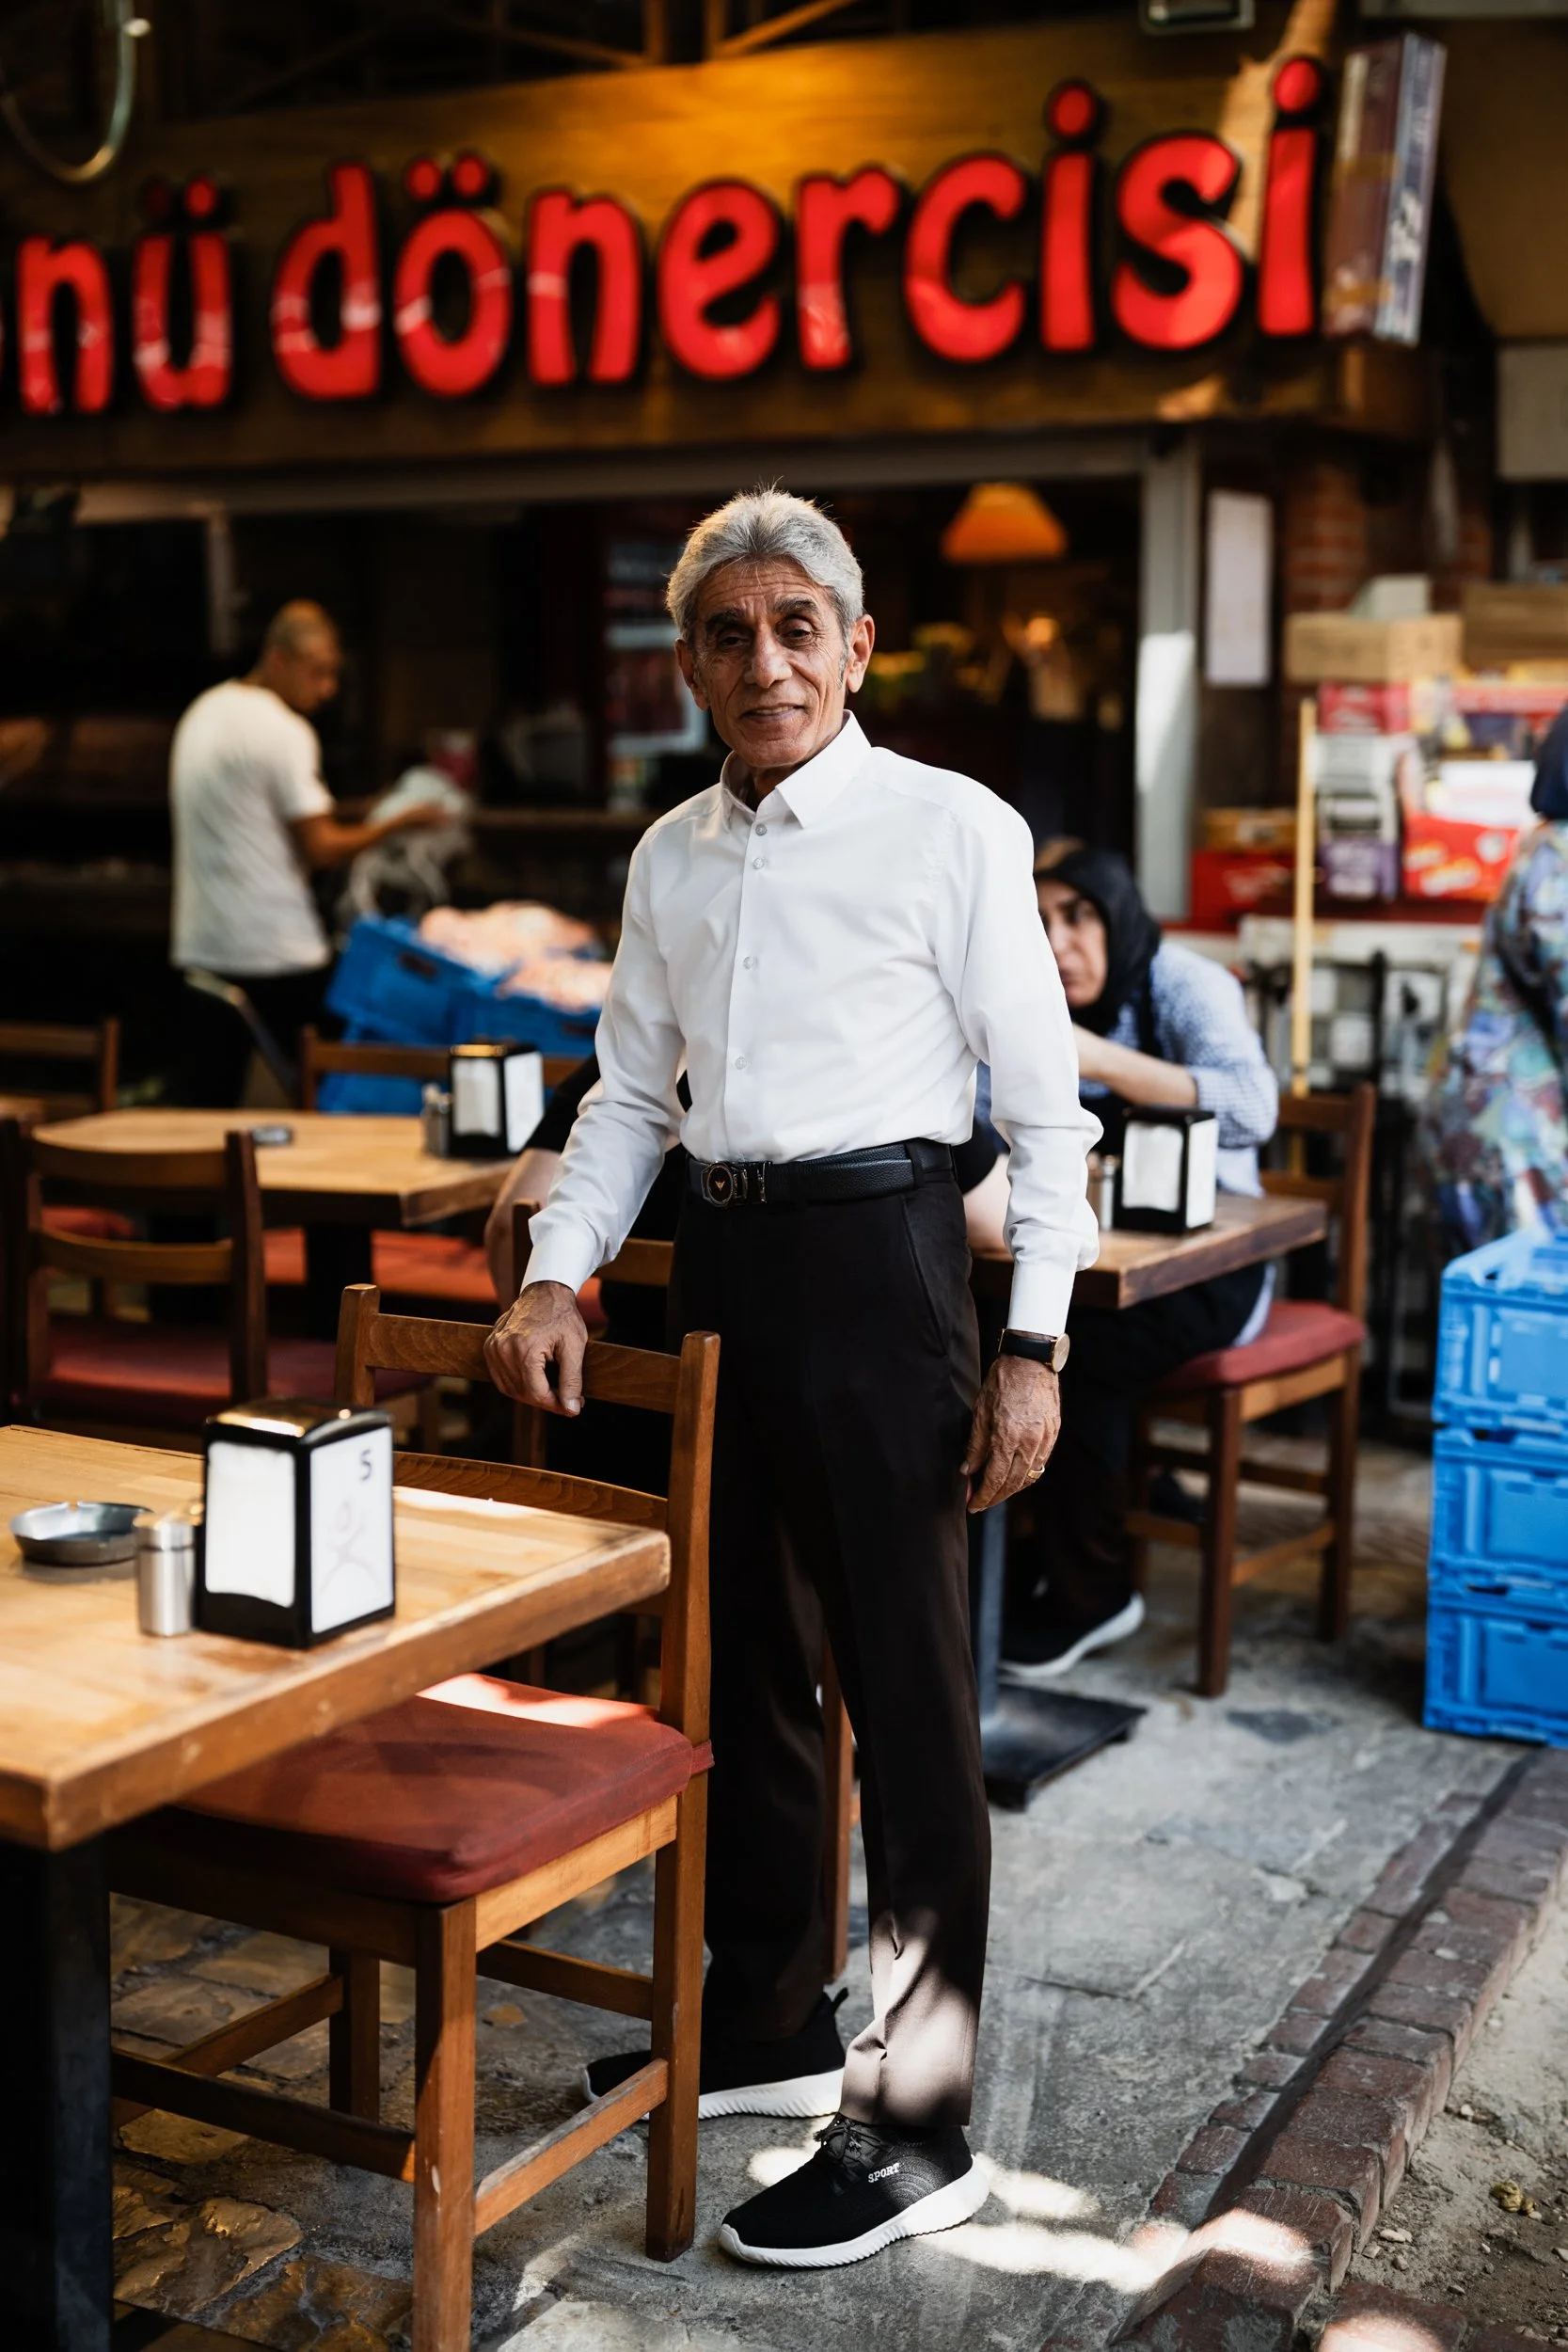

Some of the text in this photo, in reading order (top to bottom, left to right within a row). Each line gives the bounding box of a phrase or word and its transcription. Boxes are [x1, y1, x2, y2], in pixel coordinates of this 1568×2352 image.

[0, 56, 1319, 415] nü dönercisi
[358, 1448, 372, 1483] 5
[867, 2162, 900, 2183] SPORT
